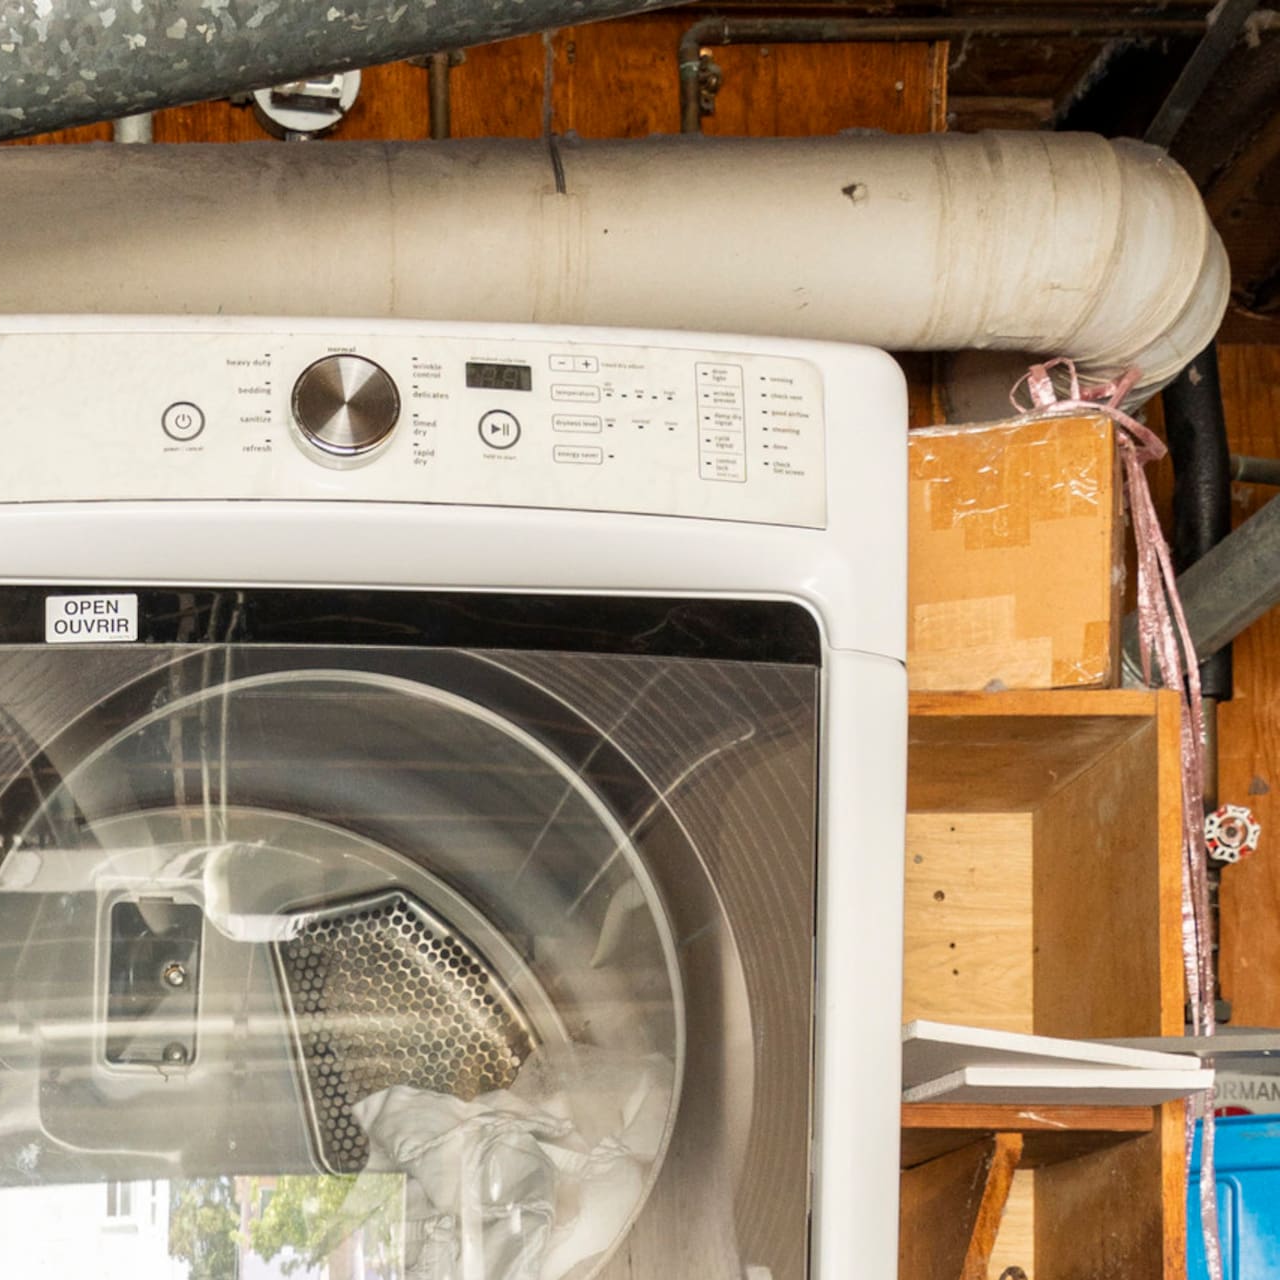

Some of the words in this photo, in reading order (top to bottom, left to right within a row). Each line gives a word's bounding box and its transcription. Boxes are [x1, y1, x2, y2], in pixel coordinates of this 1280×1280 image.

[226, 359, 250, 367] heavy
[238, 387, 272, 395] bedding
[412, 391, 449, 399] delicates
[240, 415, 272, 423] sanitize
[242, 444, 272, 452] refresh
[64, 600, 119, 615] OPEN
[54, 618, 129, 634] OUVRIR
